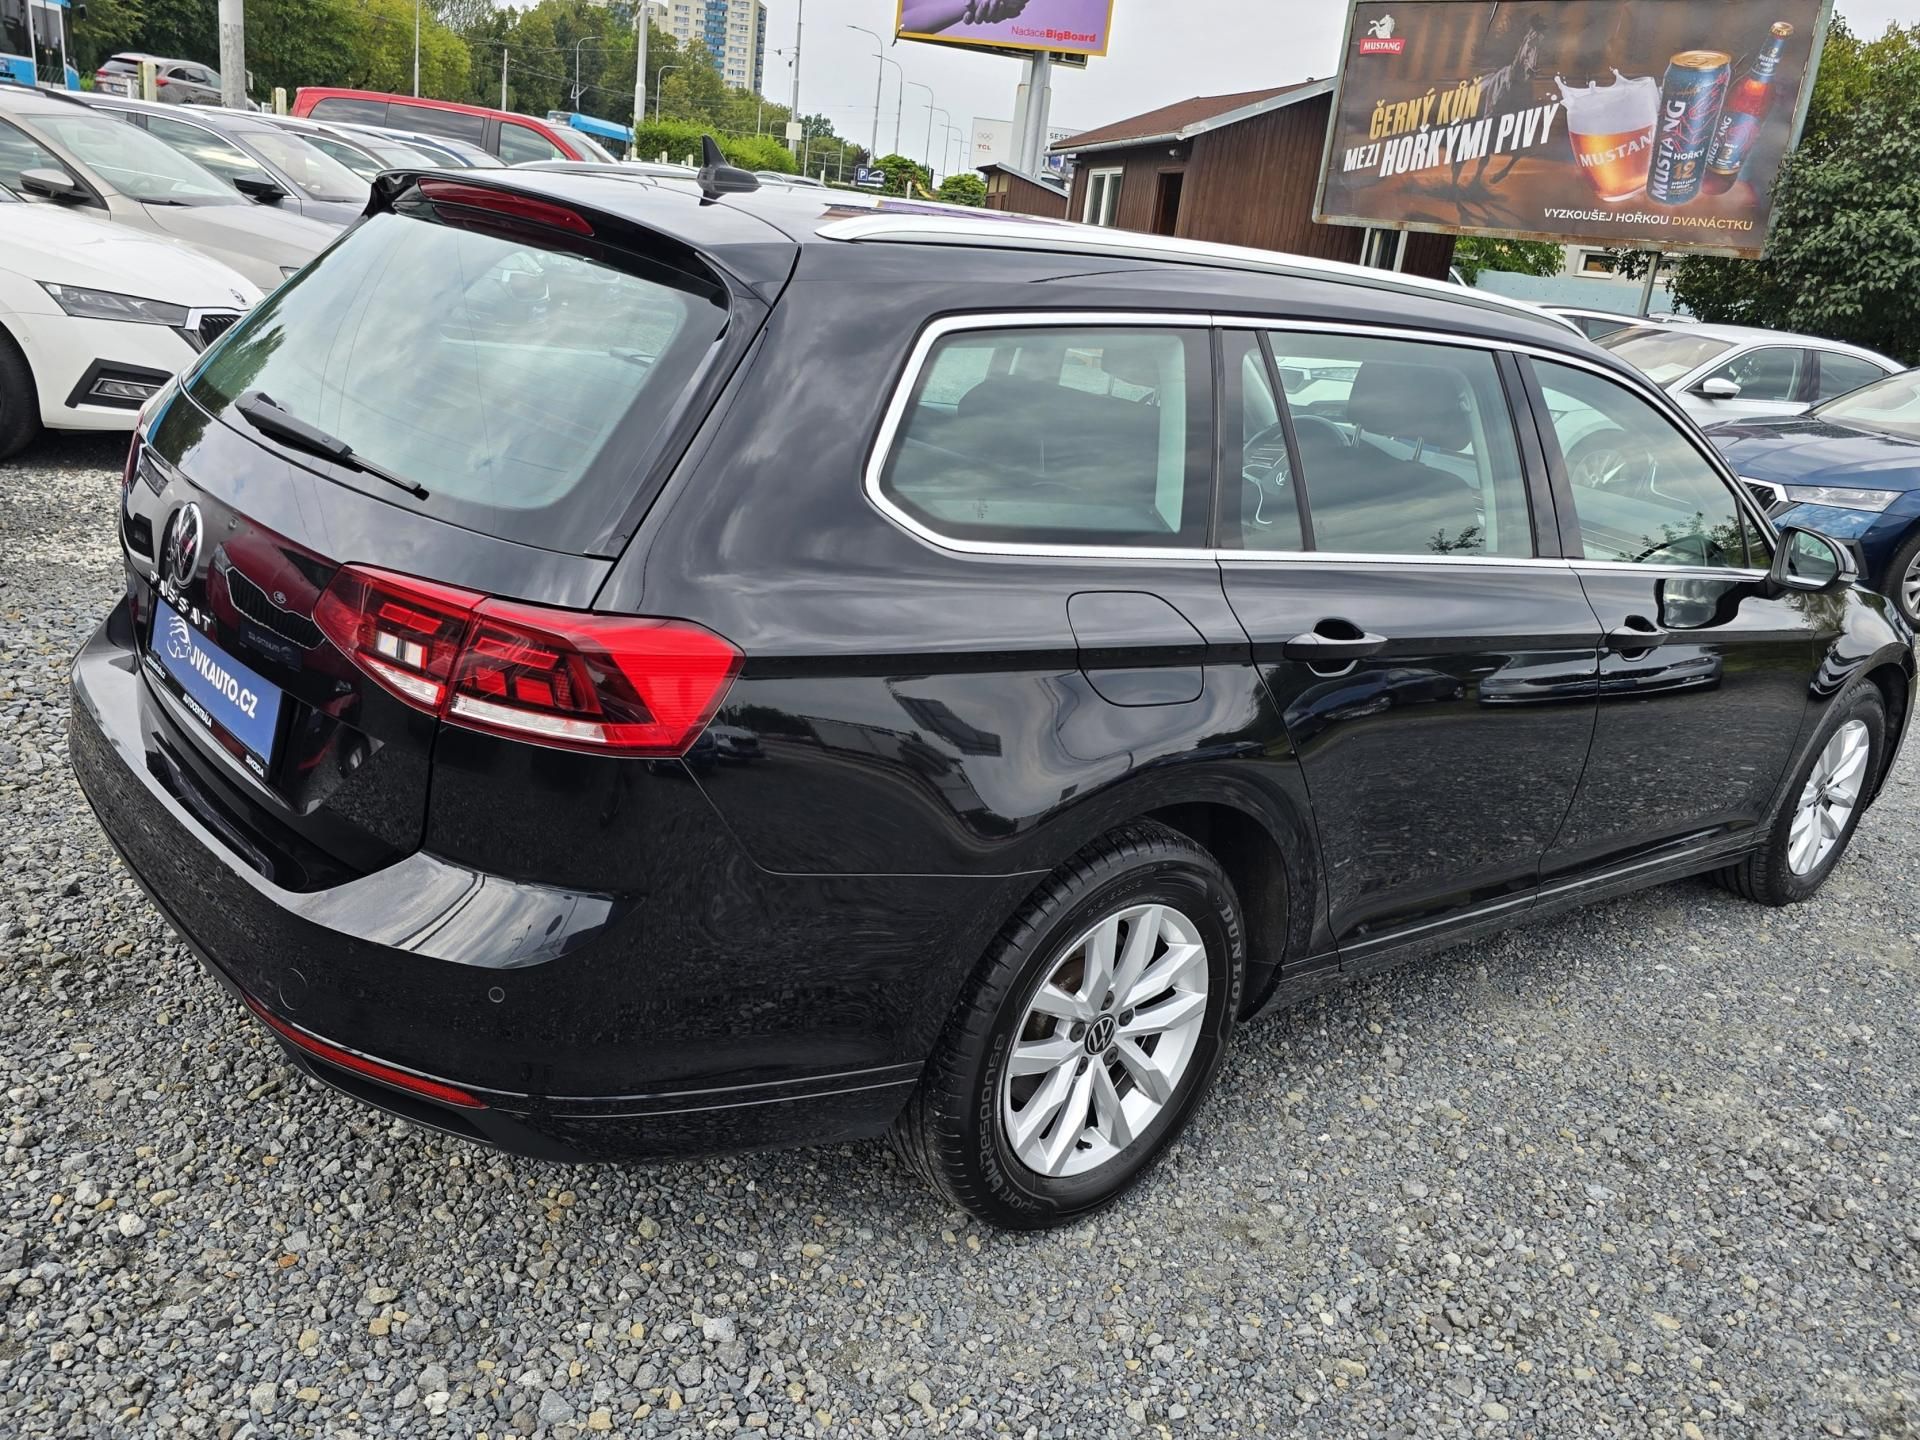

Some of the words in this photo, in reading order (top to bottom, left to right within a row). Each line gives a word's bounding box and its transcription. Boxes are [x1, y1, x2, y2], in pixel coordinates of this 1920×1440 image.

[1363, 41, 1401, 51] MUSTANG
[1343, 143, 1381, 173] MEZI
[1379, 118, 1493, 178] HOŘKÝMI
[1494, 102, 1560, 155] PIVY
[1369, 87, 1436, 140] ČERNÝ
[1437, 76, 1483, 126] KŮŇ
[1652, 100, 1686, 200] MUSTANG
[1544, 208, 1613, 223] VYZKOUŠEJ
[1616, 211, 1669, 225] HOŘKOU
[1671, 215, 1753, 231] DVANÁCTKU
[189, 645, 258, 719] JVKAUTO.CZ
